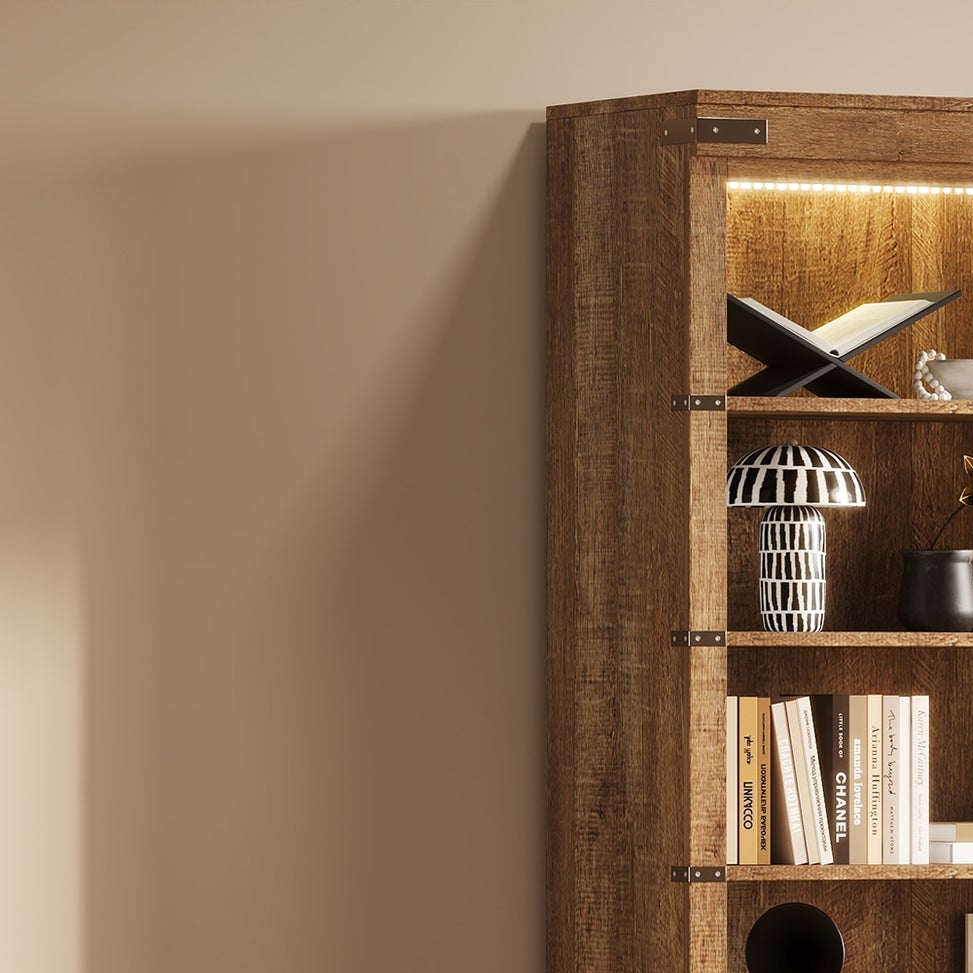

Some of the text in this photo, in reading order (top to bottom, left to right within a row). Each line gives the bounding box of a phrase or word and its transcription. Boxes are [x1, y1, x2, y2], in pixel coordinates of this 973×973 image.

[918, 710, 926, 735] Karen
[853, 738, 863, 825] amanda lovelace
[870, 725, 880, 836] Arianna Huffington
[915, 739, 926, 786] McCartney
[836, 772, 847, 843] CHANEL
